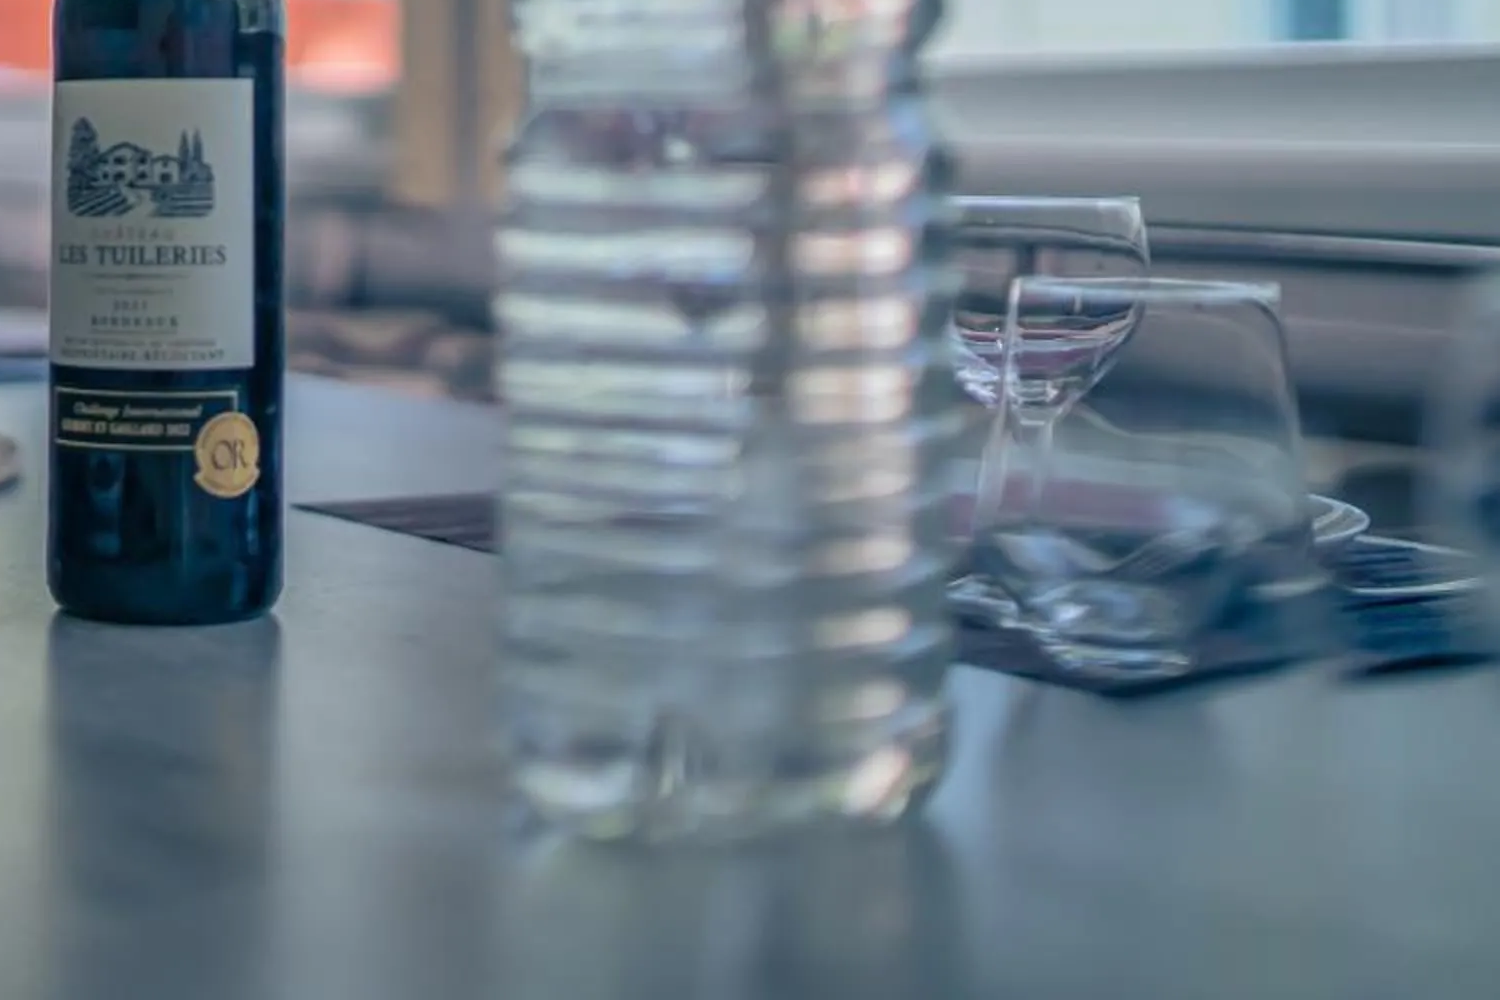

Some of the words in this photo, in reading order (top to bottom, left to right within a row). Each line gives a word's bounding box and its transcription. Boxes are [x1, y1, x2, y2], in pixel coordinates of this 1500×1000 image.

[59, 243, 88, 266] LES
[95, 244, 228, 267] TUILERIES
[211, 438, 250, 471] OR
